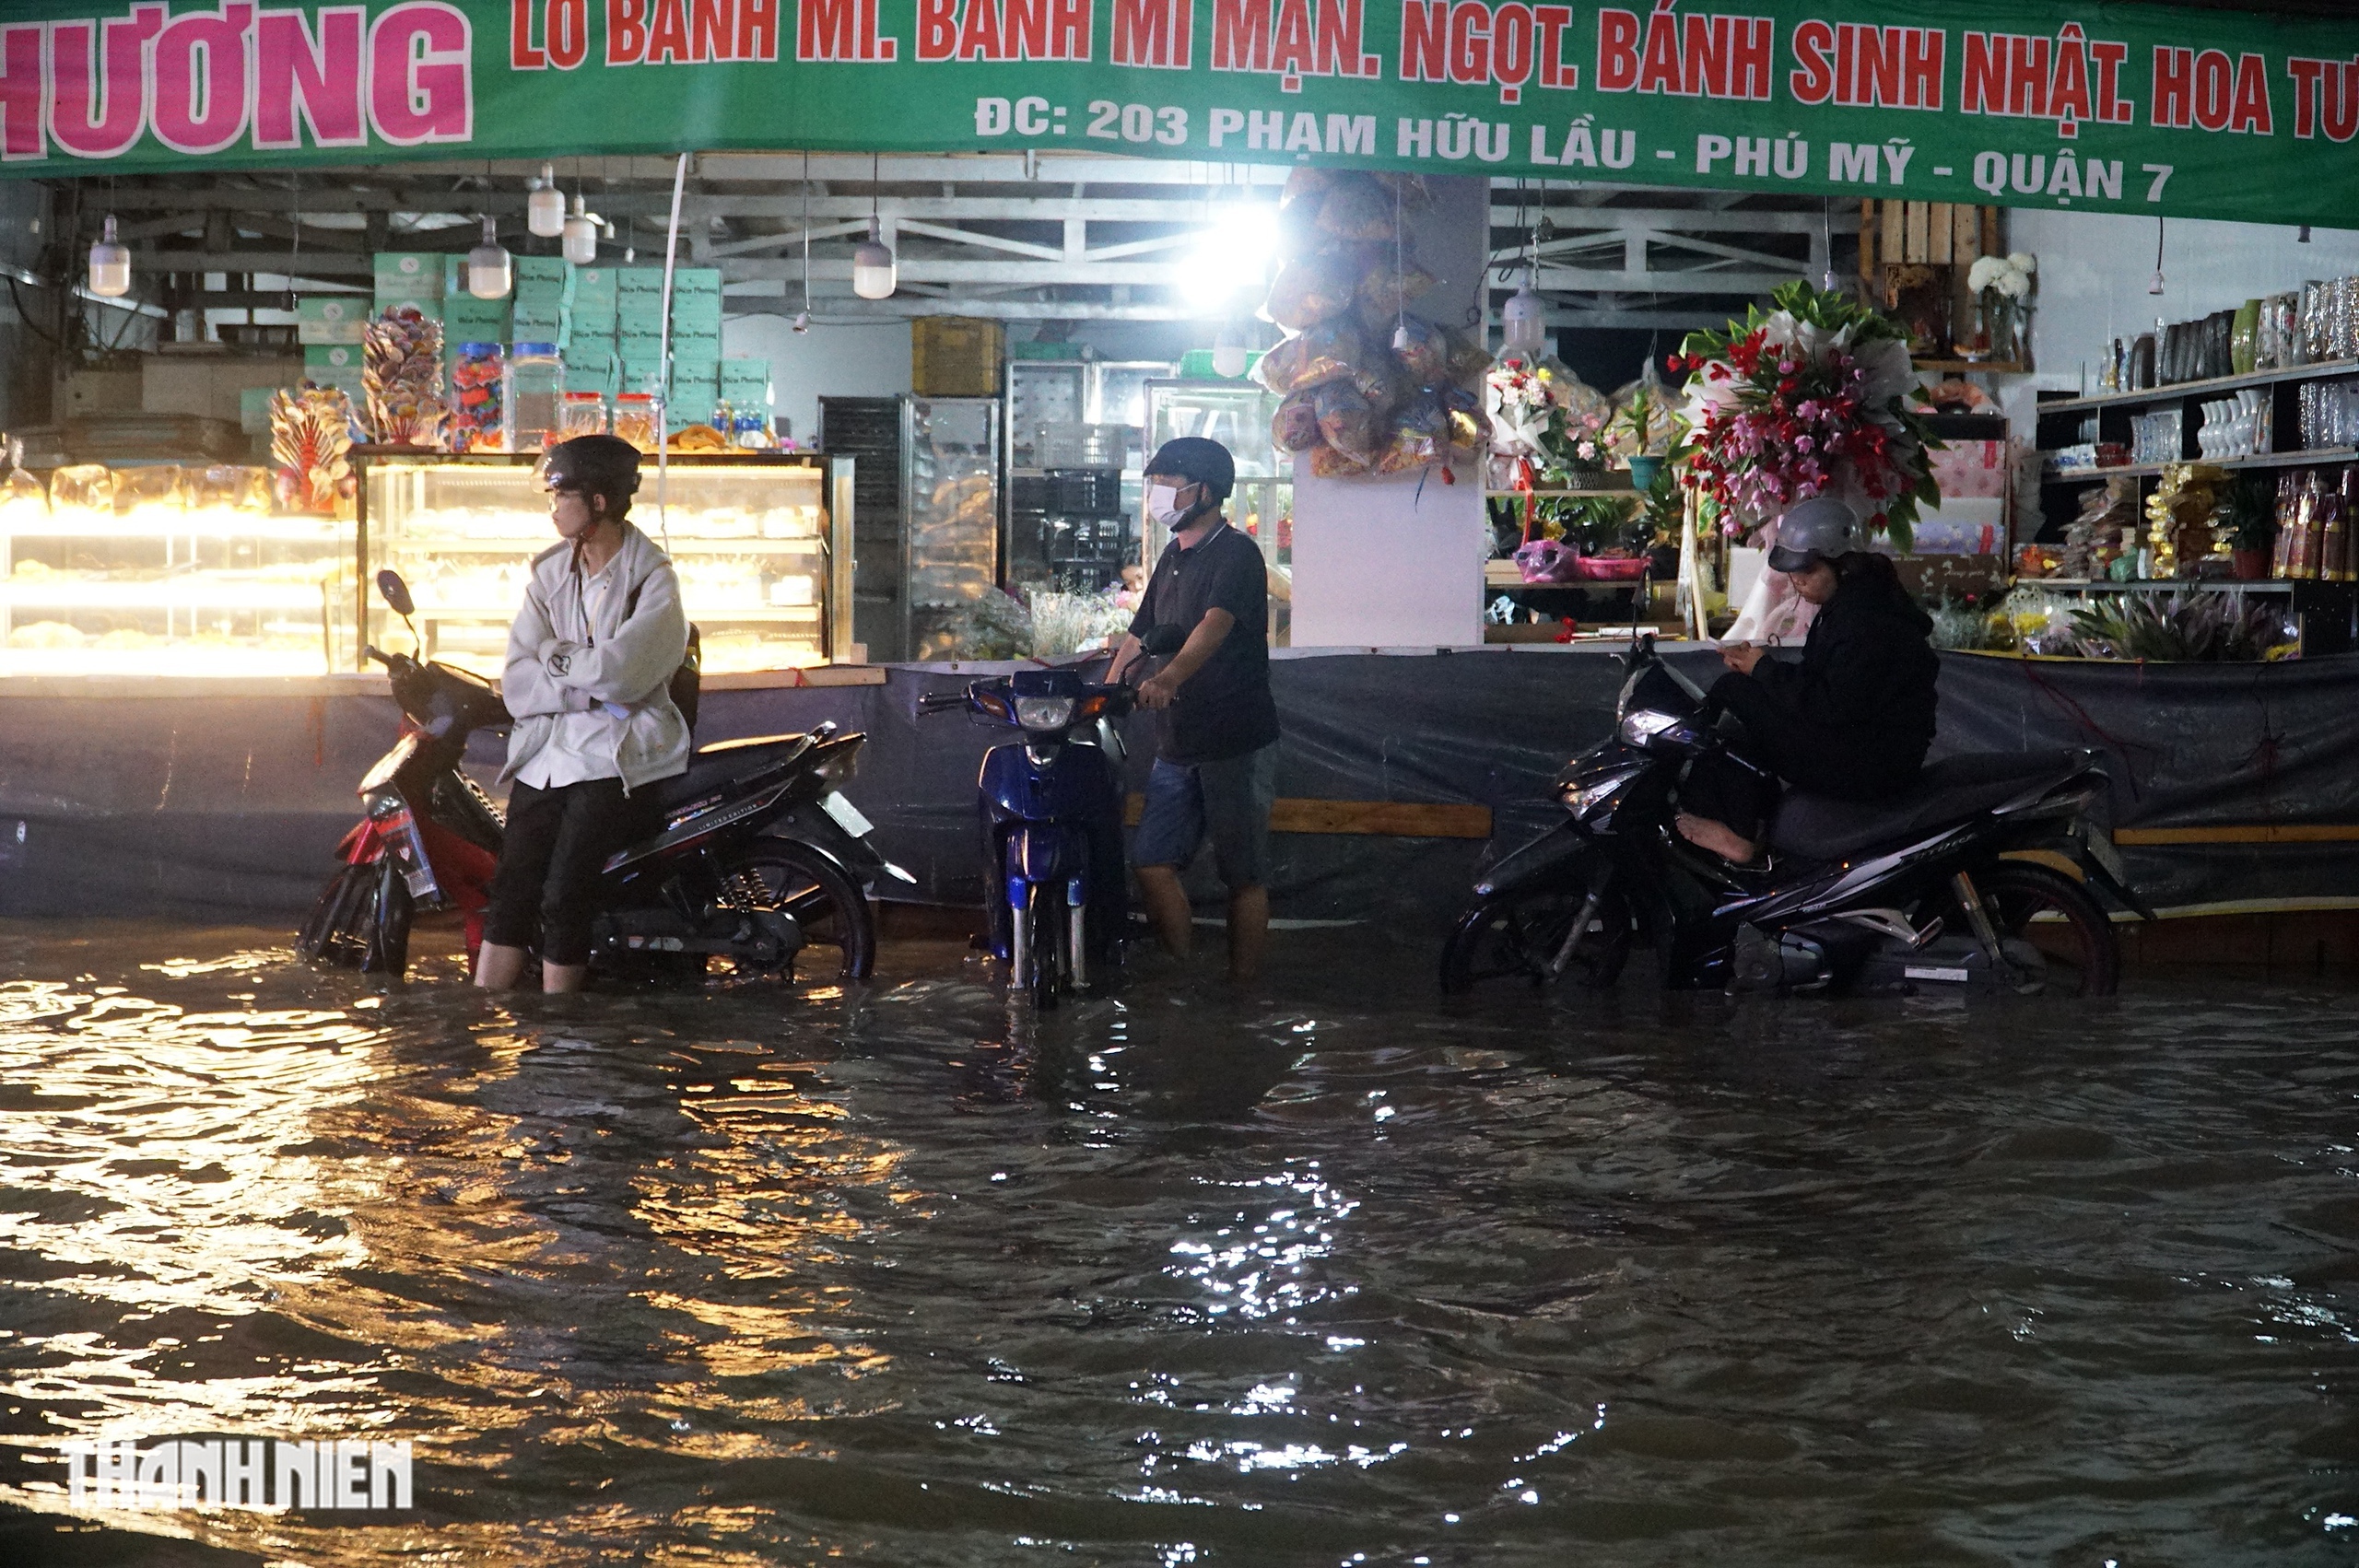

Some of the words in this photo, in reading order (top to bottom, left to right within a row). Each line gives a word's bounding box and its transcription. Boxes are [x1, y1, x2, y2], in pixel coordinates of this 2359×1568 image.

[1399, 0, 1578, 105] NGỌT.
[1596, 0, 1775, 101] BÁNH
[1790, 19, 1946, 111] SINH
[1960, 21, 2134, 139] NHẬT.
[2151, 44, 2273, 136] HOA
[974, 97, 1067, 136] ĐC:
[1086, 99, 1189, 146] 203
[1208, 108, 1377, 160] PHẠM
[1397, 112, 1509, 162] HỮU
[1531, 113, 1636, 169] LẦU
[1656, 150, 1676, 159] -
[1696, 131, 1808, 179] PHÚ
[1829, 137, 1916, 184] MỸ
[1933, 167, 1953, 176] -
[1973, 147, 2123, 205] QUẬN
[2142, 163, 2174, 203] 7
